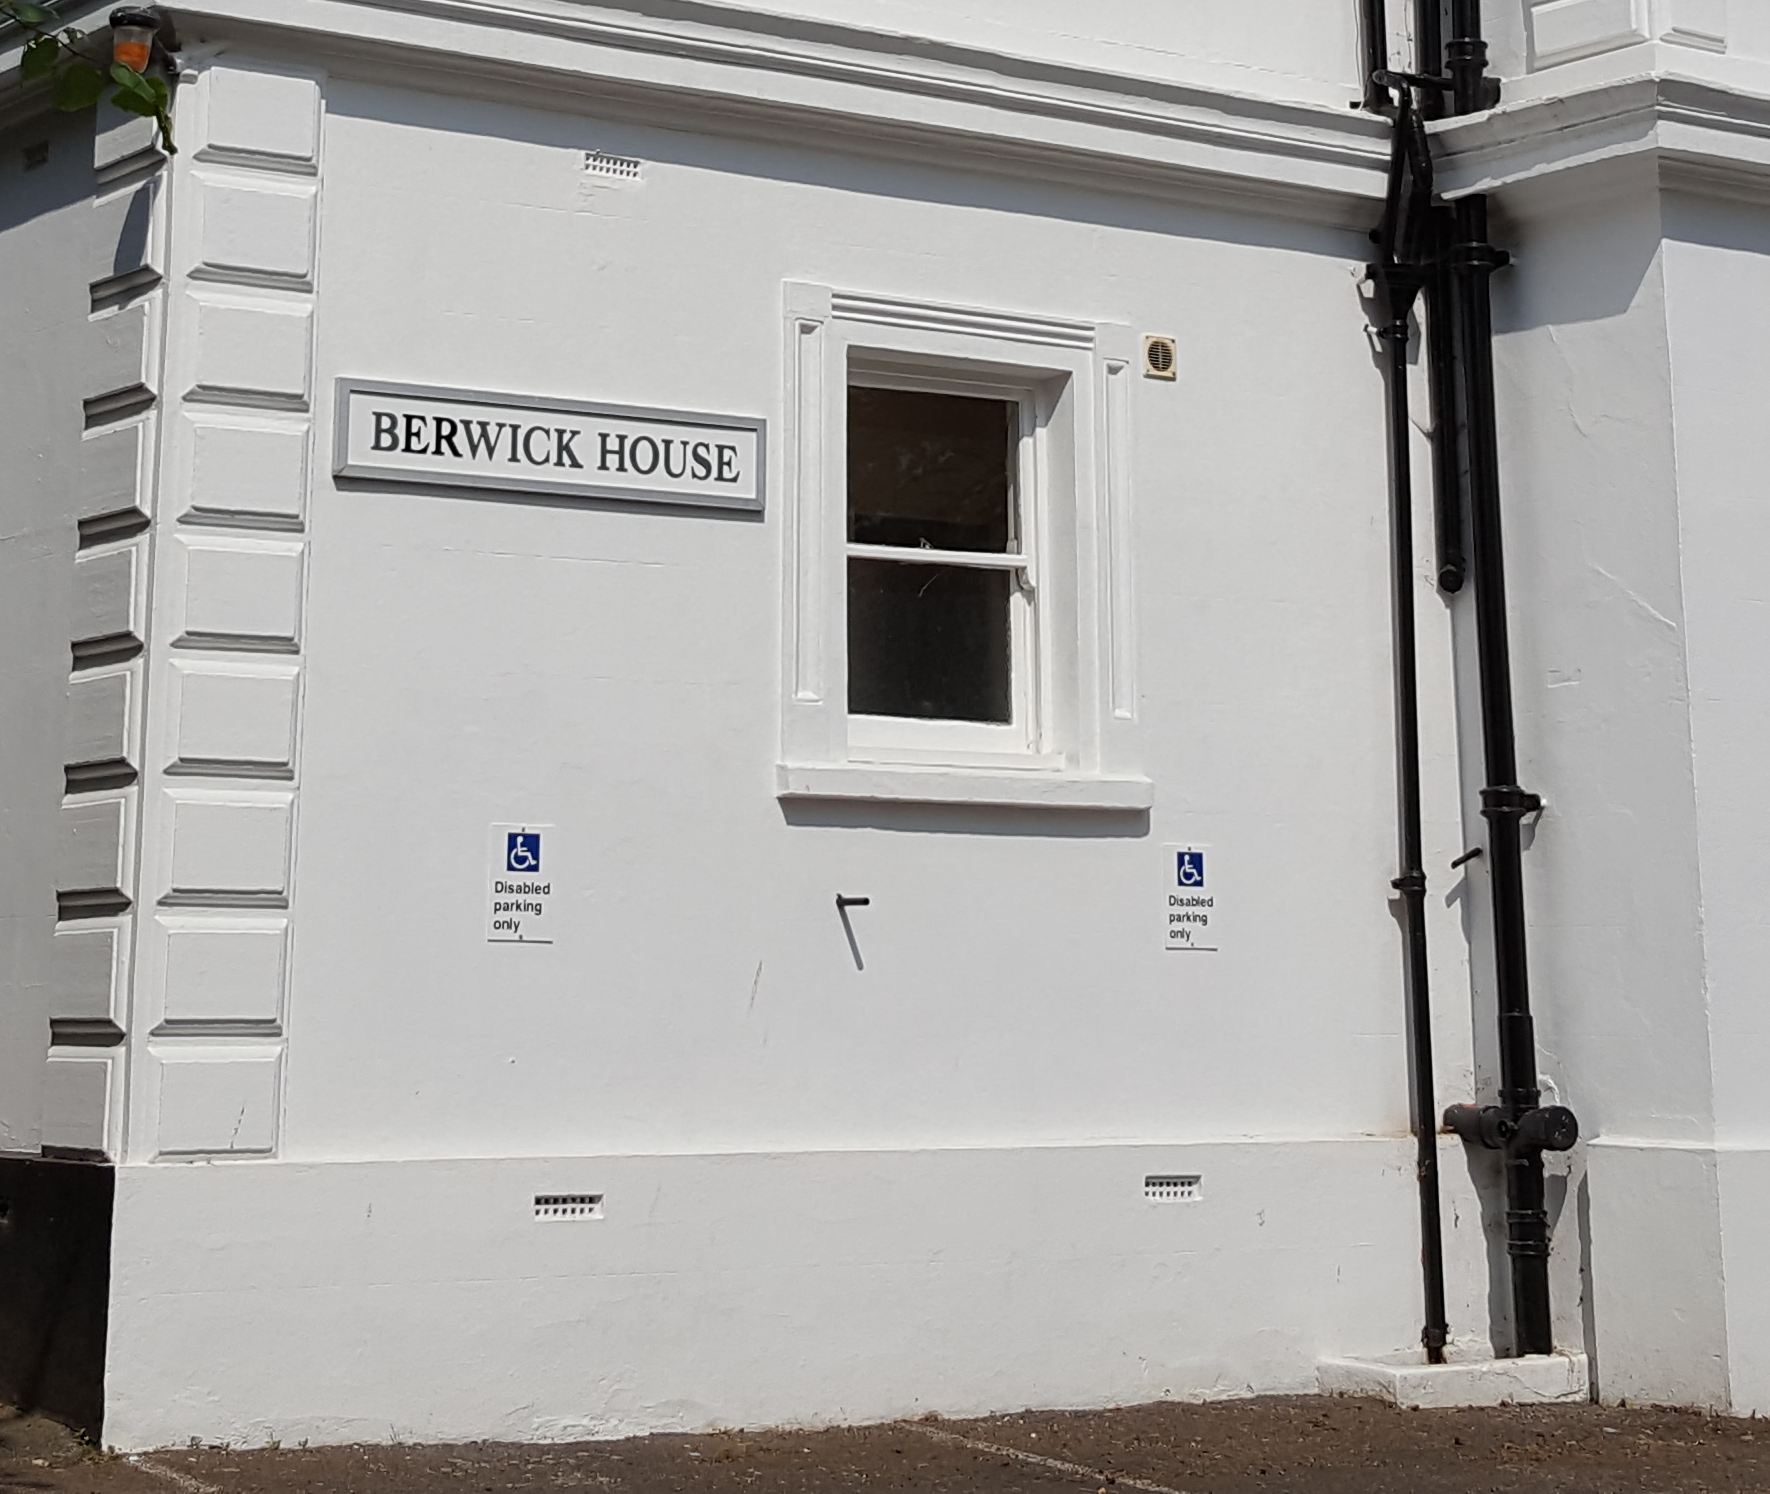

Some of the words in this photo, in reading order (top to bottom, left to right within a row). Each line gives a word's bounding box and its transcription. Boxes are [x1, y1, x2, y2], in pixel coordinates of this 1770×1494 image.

[370, 410, 584, 470] BERWICK
[596, 431, 741, 484] HOUSE
[494, 881, 551, 896] Disabled
[493, 900, 543, 916] parking
[1168, 895, 1214, 908] Disabled
[493, 918, 521, 934] only
[1168, 911, 1208, 926] parking
[1169, 928, 1192, 943] only
